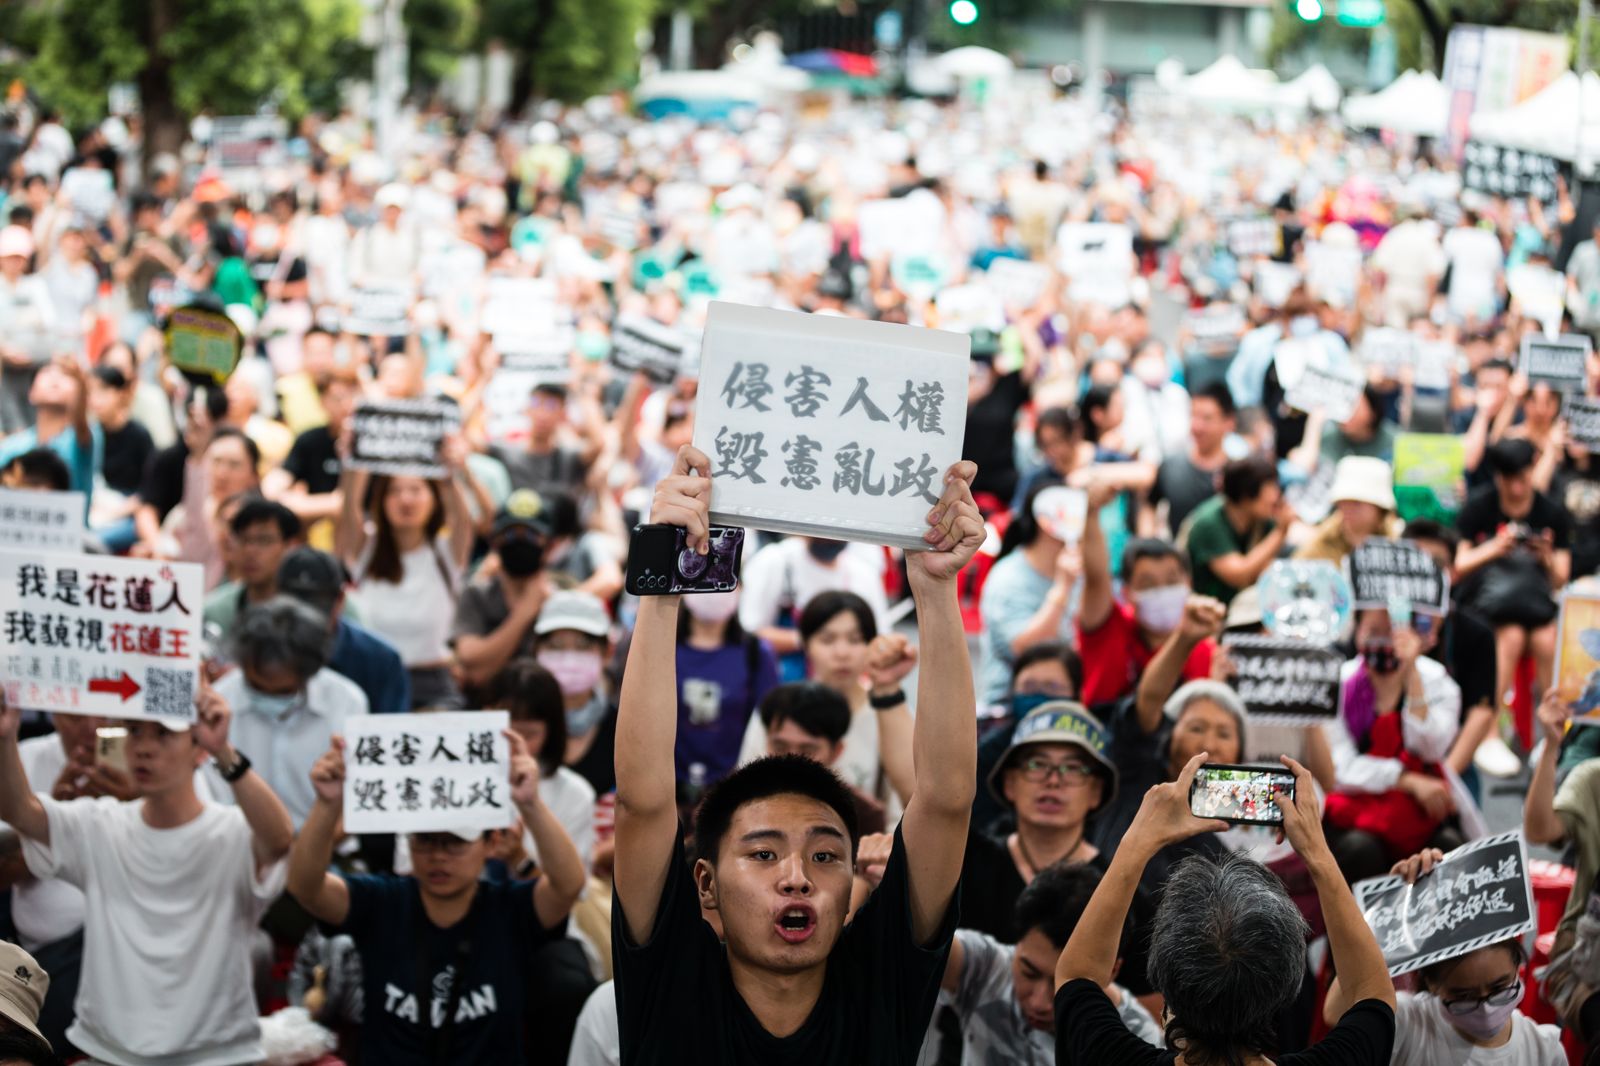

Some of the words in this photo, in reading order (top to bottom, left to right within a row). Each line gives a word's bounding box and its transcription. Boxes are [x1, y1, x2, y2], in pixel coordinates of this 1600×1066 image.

[720, 361, 945, 435] 侵害人權
[712, 426, 940, 506] 毀憲亂政
[17, 564, 190, 615] 我是花蓮人
[4, 610, 190, 658] 我藐視花蓮王
[355, 731, 498, 765] 侵害人權
[354, 777, 502, 811] 毀憲亂政
